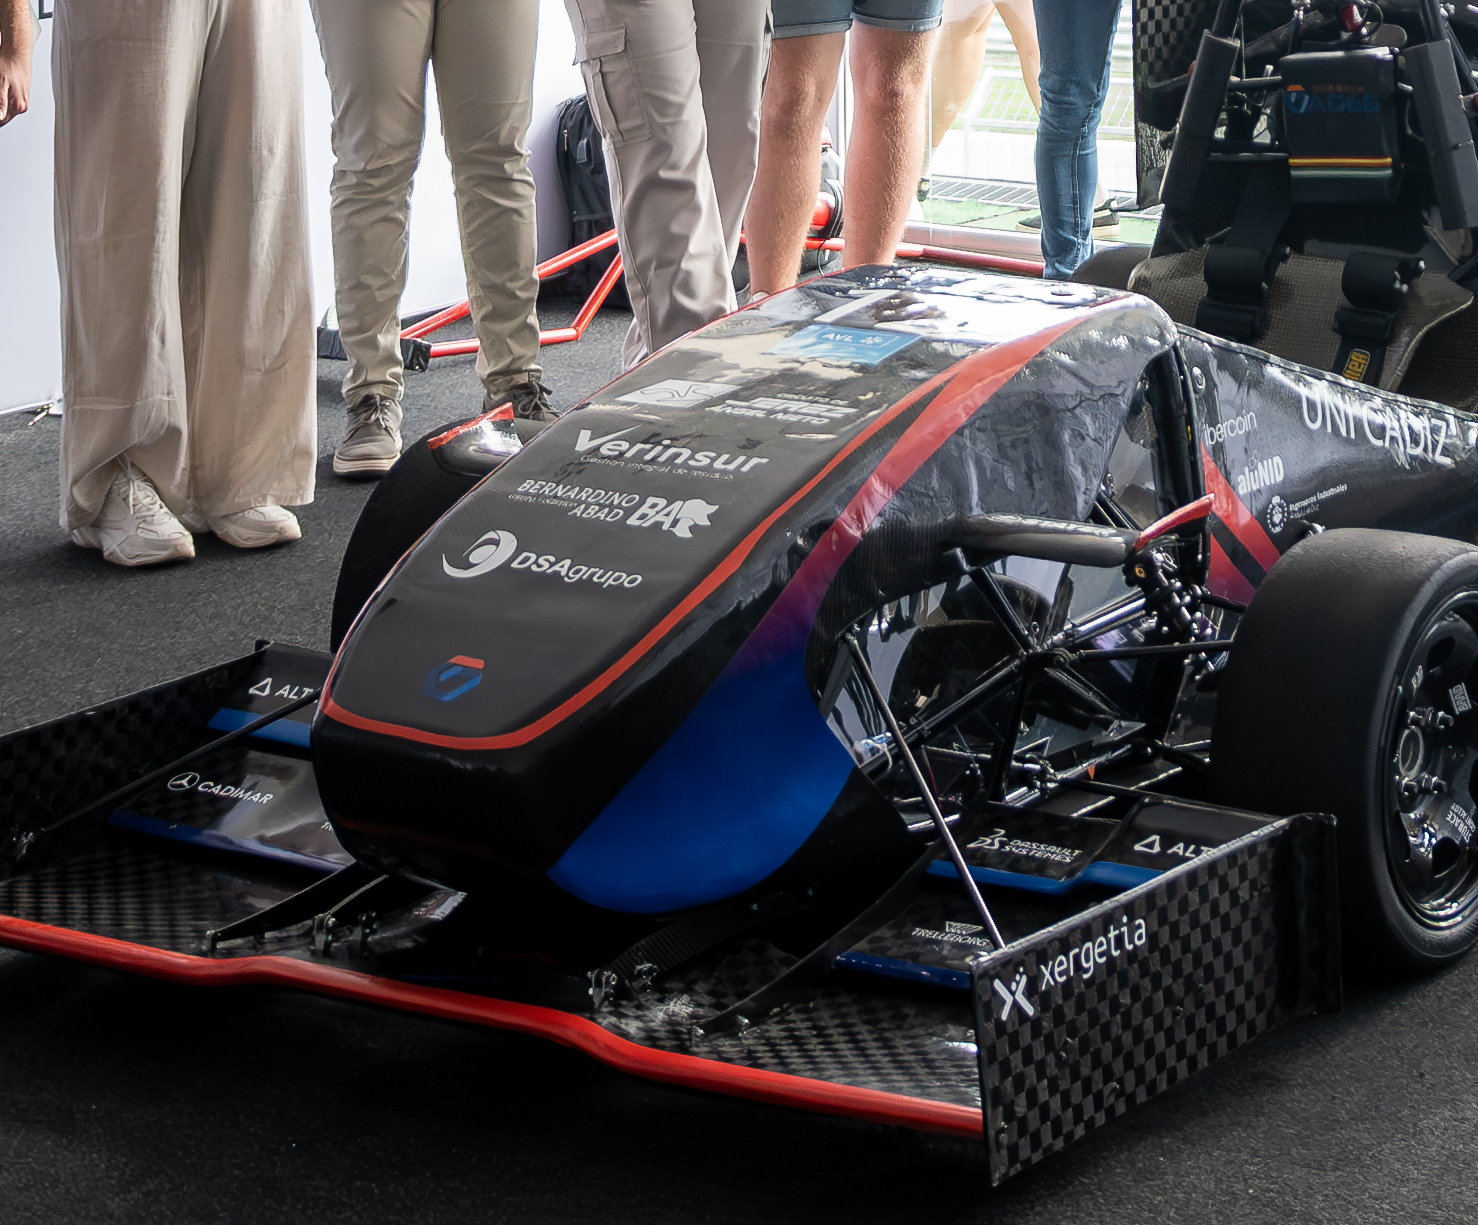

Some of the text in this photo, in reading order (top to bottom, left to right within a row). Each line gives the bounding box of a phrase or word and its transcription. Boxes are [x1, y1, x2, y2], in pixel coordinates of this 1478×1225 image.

[822, 332, 853, 343] AVL
[1204, 409, 1257, 447] ibercoin
[574, 424, 771, 473] Verinsur
[1237, 455, 1284, 495] aluNID
[516, 479, 640, 508] BERNARDINO
[568, 503, 624, 522] ABAD
[510, 551, 643, 588] DSAgrupo
[197, 780, 274, 805] CADIMAR
[1010, 838, 1083, 857] DASSAULT
[911, 927, 990, 947] TRELLEBORG
[1040, 914, 1147, 992] xergetia
